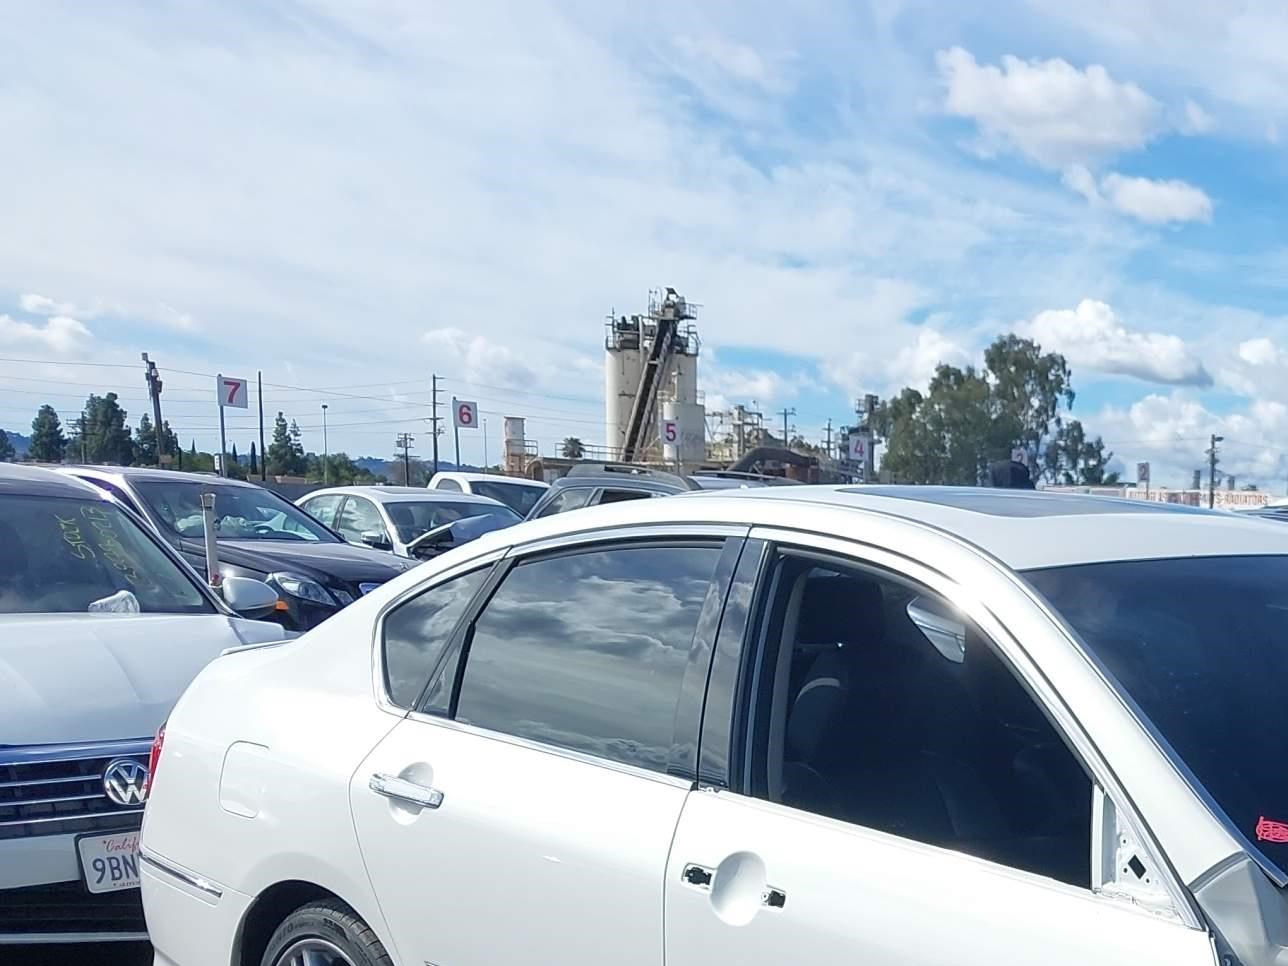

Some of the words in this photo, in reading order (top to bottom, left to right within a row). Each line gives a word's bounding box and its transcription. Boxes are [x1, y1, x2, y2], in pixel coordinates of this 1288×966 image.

[223, 380, 241, 404] 7
[459, 404, 472, 424] 6
[665, 422, 677, 442] 5
[854, 439, 865, 457] 4
[92, 855, 139, 885] 9BN
